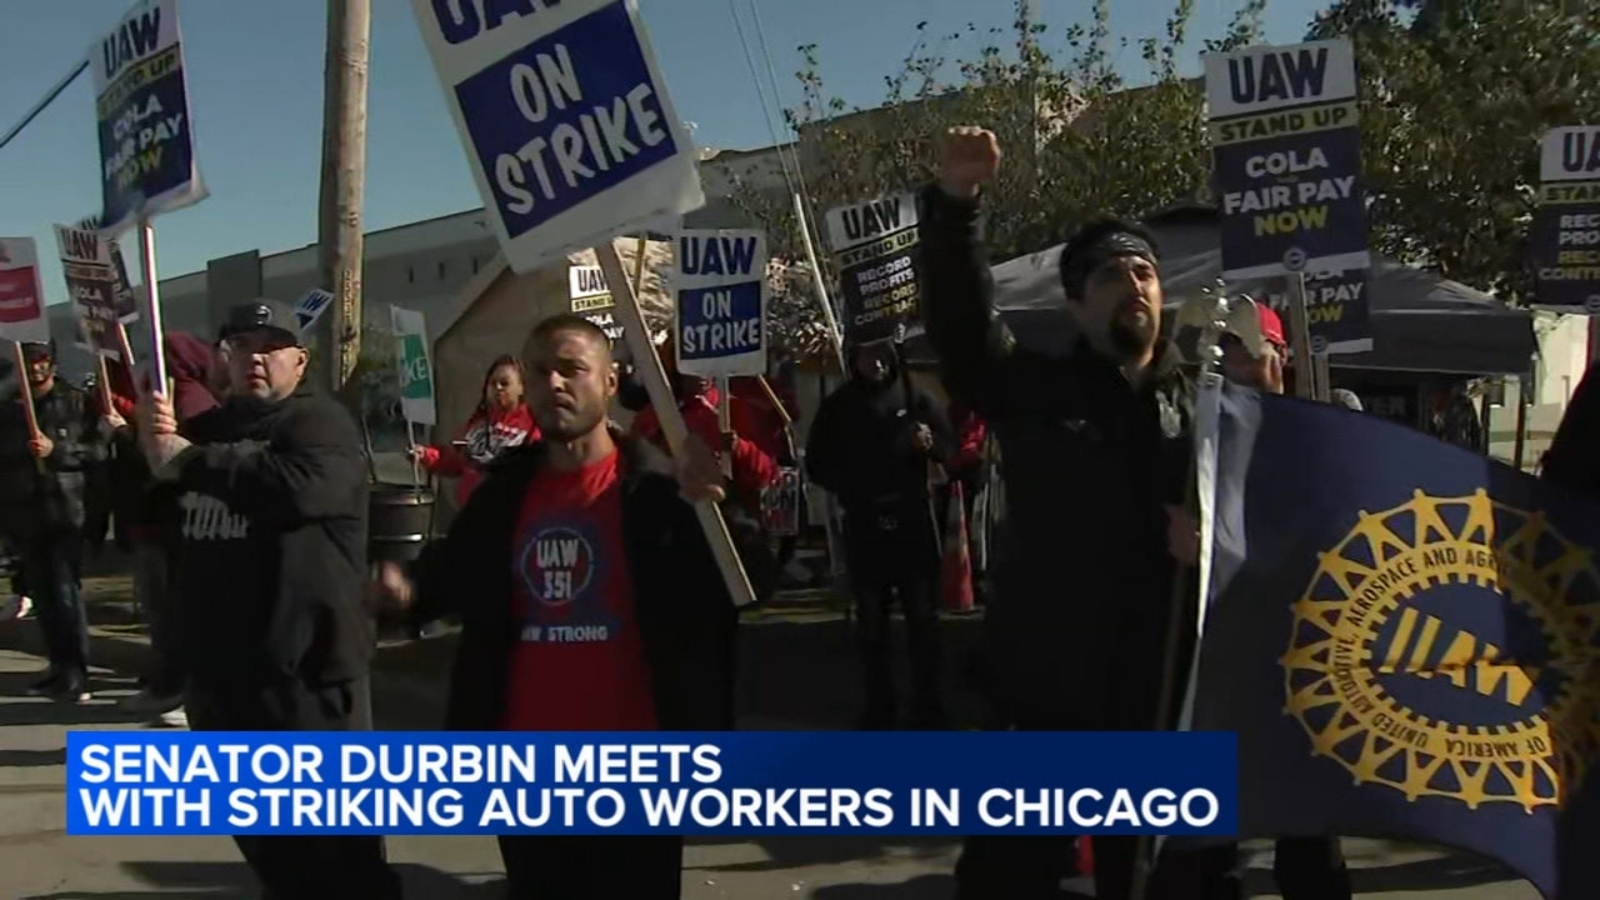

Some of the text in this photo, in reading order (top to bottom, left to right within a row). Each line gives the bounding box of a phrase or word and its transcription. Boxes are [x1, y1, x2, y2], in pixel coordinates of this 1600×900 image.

[103, 7, 160, 80] UAW
[150, 54, 174, 76] UP
[1229, 49, 1327, 104] UAW
[510, 44, 582, 123] ON
[139, 112, 183, 150] PAY
[1221, 107, 1346, 141] STAND UP
[495, 83, 666, 215] STRIKE
[1246, 147, 1329, 178] COLA
[1563, 132, 1600, 172] UA
[1224, 175, 1355, 215] FAIR PAY
[843, 197, 900, 240] UAW
[1254, 206, 1328, 236] NOW
[1560, 214, 1600, 229] REC
[61, 228, 97, 261] UAW
[842, 231, 916, 263] STAND UP
[1559, 230, 1600, 246] PRO
[681, 237, 756, 275] UAW
[857, 256, 912, 284] RECORD
[860, 268, 915, 296] PROFITS
[1321, 282, 1363, 304] PAY
[702, 289, 732, 320] ON
[1308, 303, 1344, 324] OW
[682, 317, 760, 353] STRIKE
[536, 539, 579, 569] UAW
[1423, 547, 1457, 568] AND
[1346, 557, 1418, 627] AEROSPACE
[547, 625, 609, 642] STRONG
[1372, 712, 1429, 749] UNITED
[1444, 735, 1547, 758] OF AMERICA
